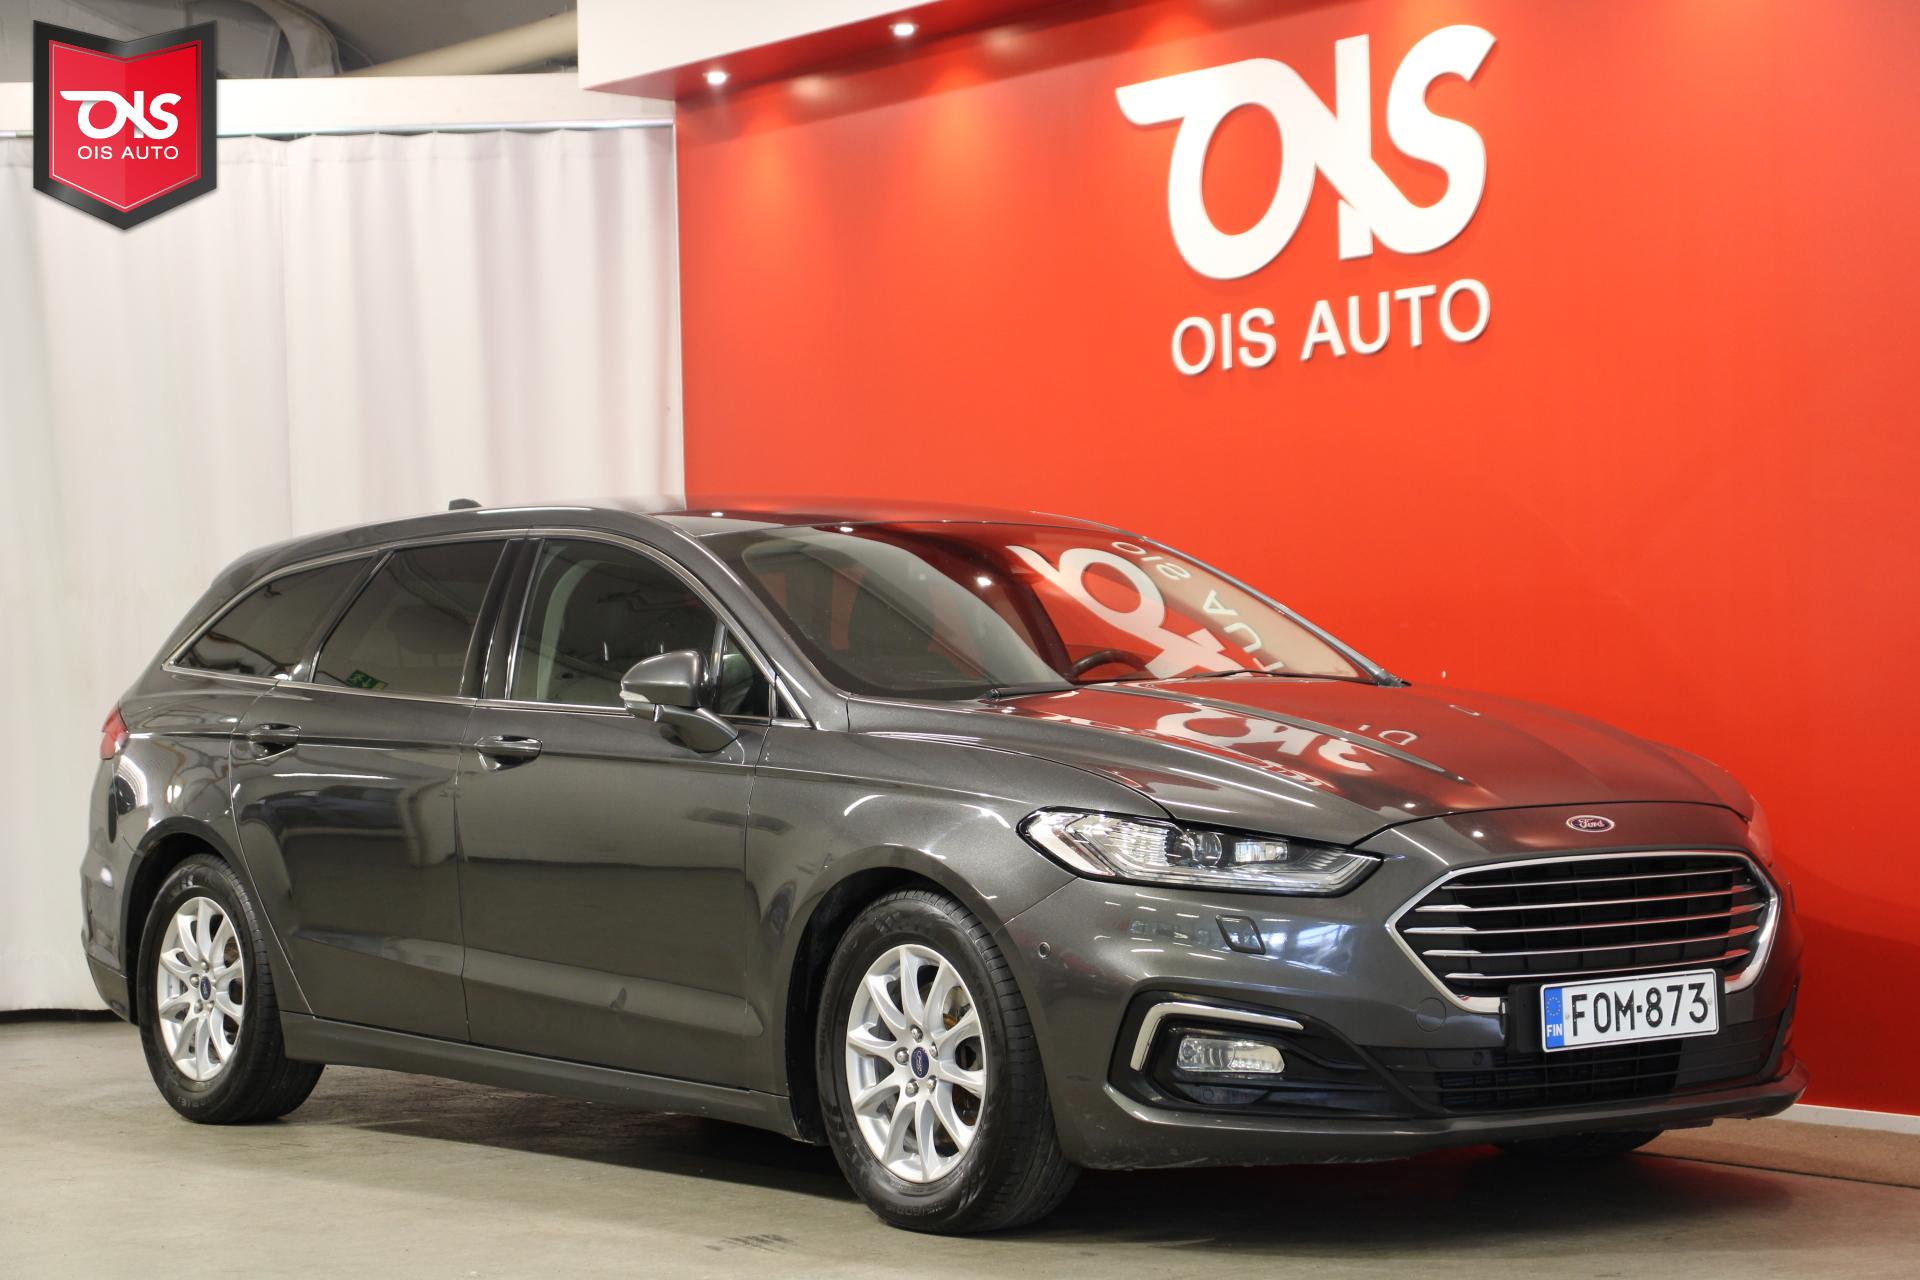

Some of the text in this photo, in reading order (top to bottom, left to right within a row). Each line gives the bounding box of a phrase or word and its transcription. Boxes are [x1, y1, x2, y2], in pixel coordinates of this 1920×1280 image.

[1171, 279, 1491, 375] OIS AUTO
[1578, 818, 1605, 829] Ford
[1571, 982, 1709, 1037] FOM-873
[1546, 1023, 1563, 1037] FIN
